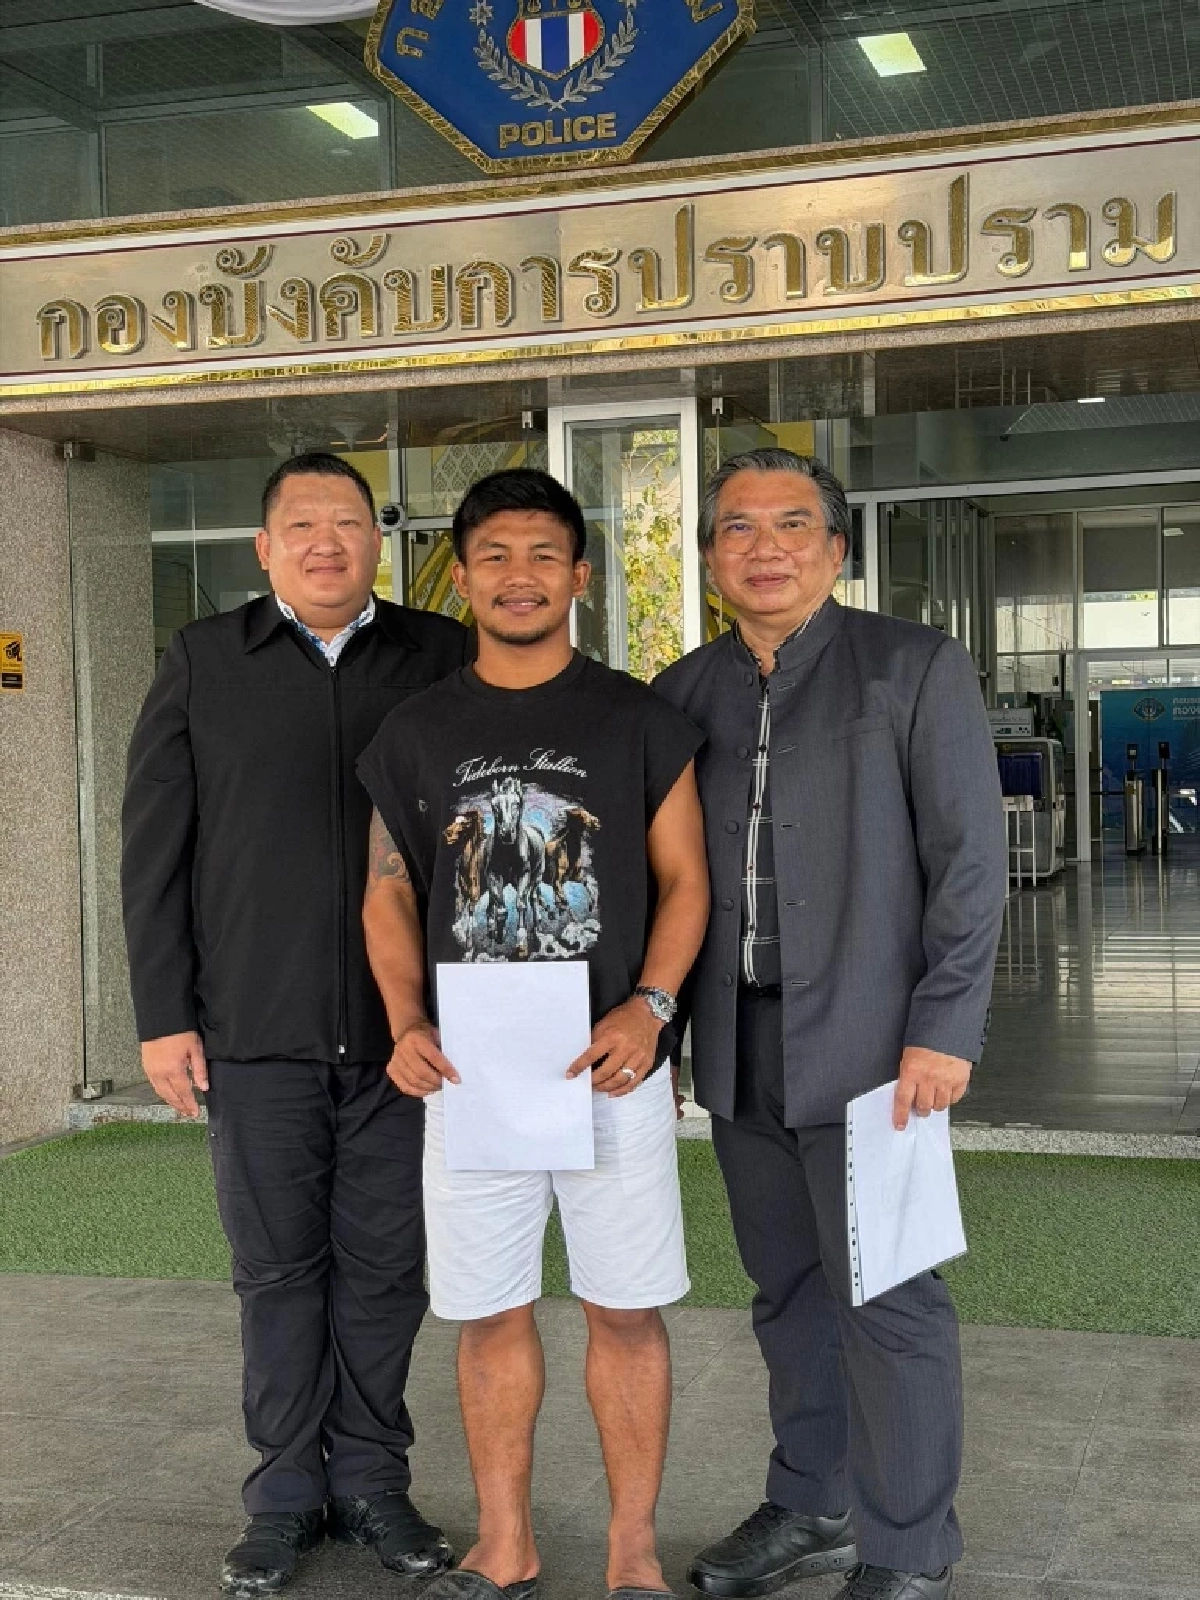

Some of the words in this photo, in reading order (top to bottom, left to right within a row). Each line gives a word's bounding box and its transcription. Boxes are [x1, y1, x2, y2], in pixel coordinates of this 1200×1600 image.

[499, 113, 616, 149] POLICE
[36, 173, 1177, 360] กองบังคับการปราบปราม
[523, 747, 588, 777] Stallion
